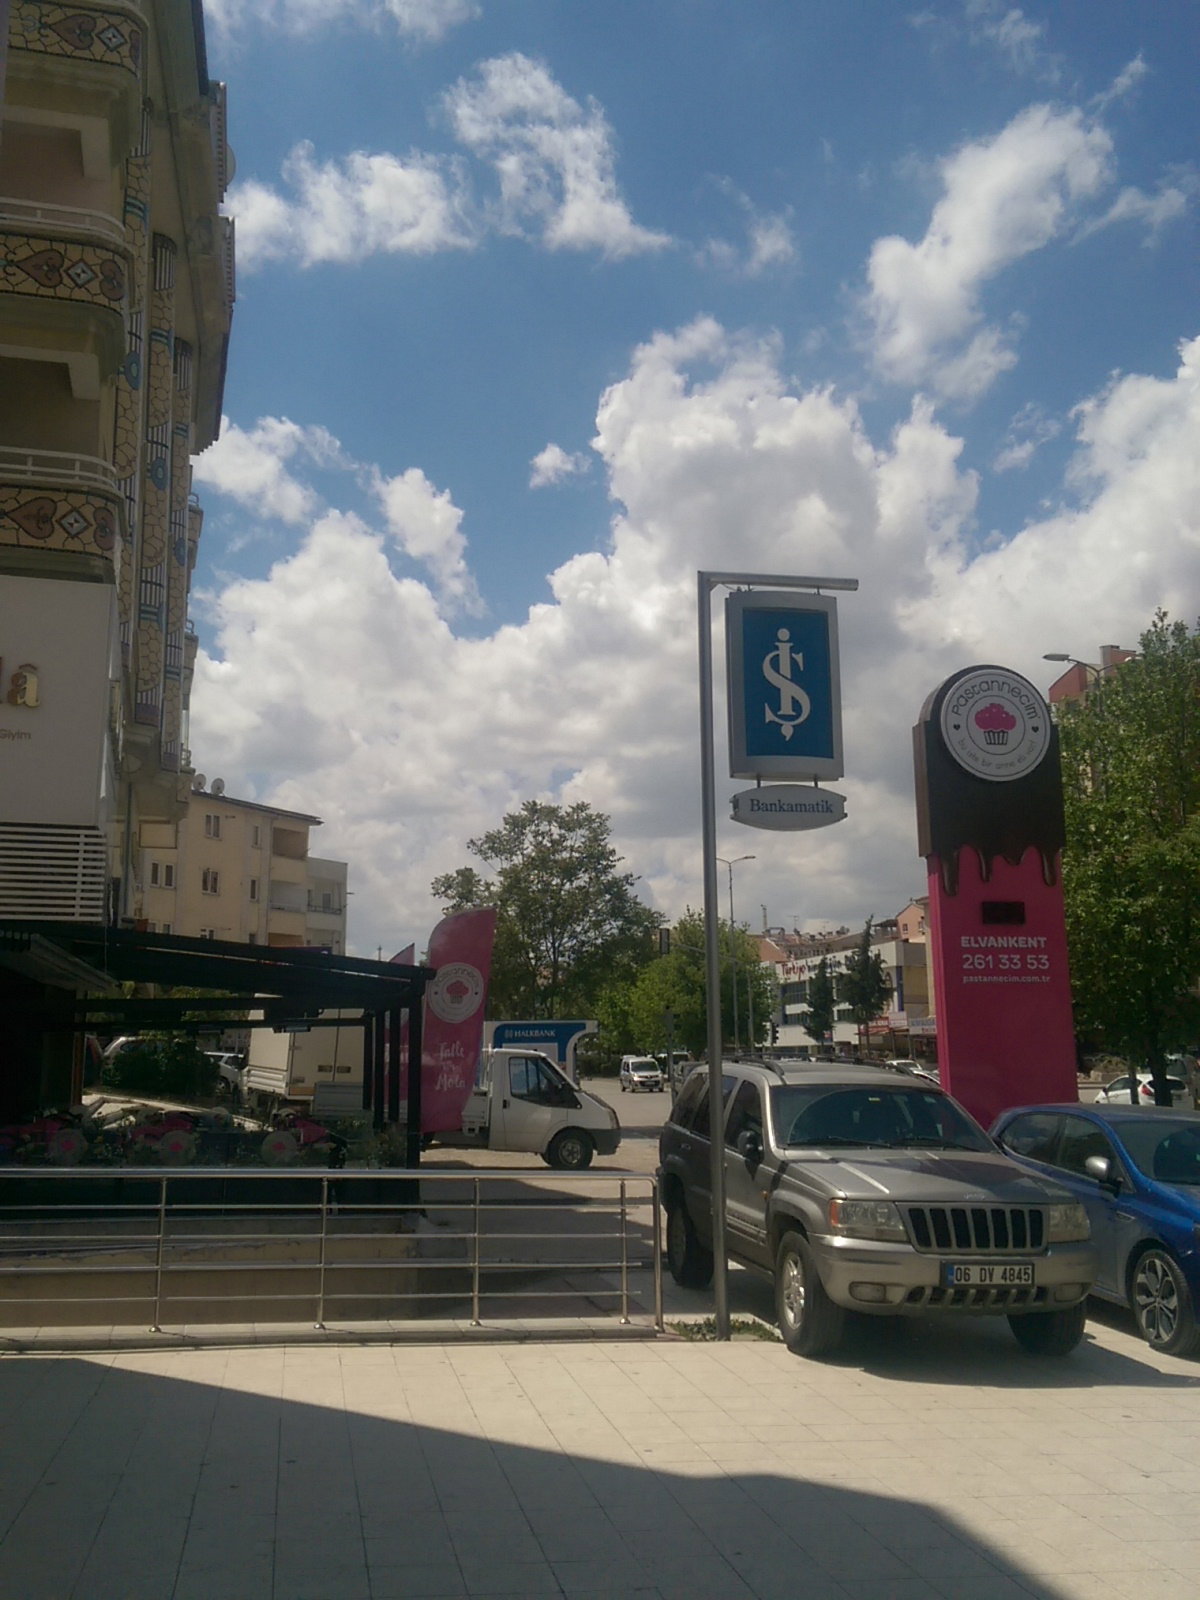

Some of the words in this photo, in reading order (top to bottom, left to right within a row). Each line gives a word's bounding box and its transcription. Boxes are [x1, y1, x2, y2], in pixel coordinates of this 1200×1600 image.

[749, 799, 833, 814] Bankamatik
[961, 936, 1047, 948] ELVANKENT
[962, 954, 994, 969] 261
[998, 954, 1022, 969] 33
[1026, 955, 1050, 970] 53
[955, 1267, 971, 1282] 06
[980, 1268, 995, 1283] DV
[1001, 1268, 1031, 1283] 4845
